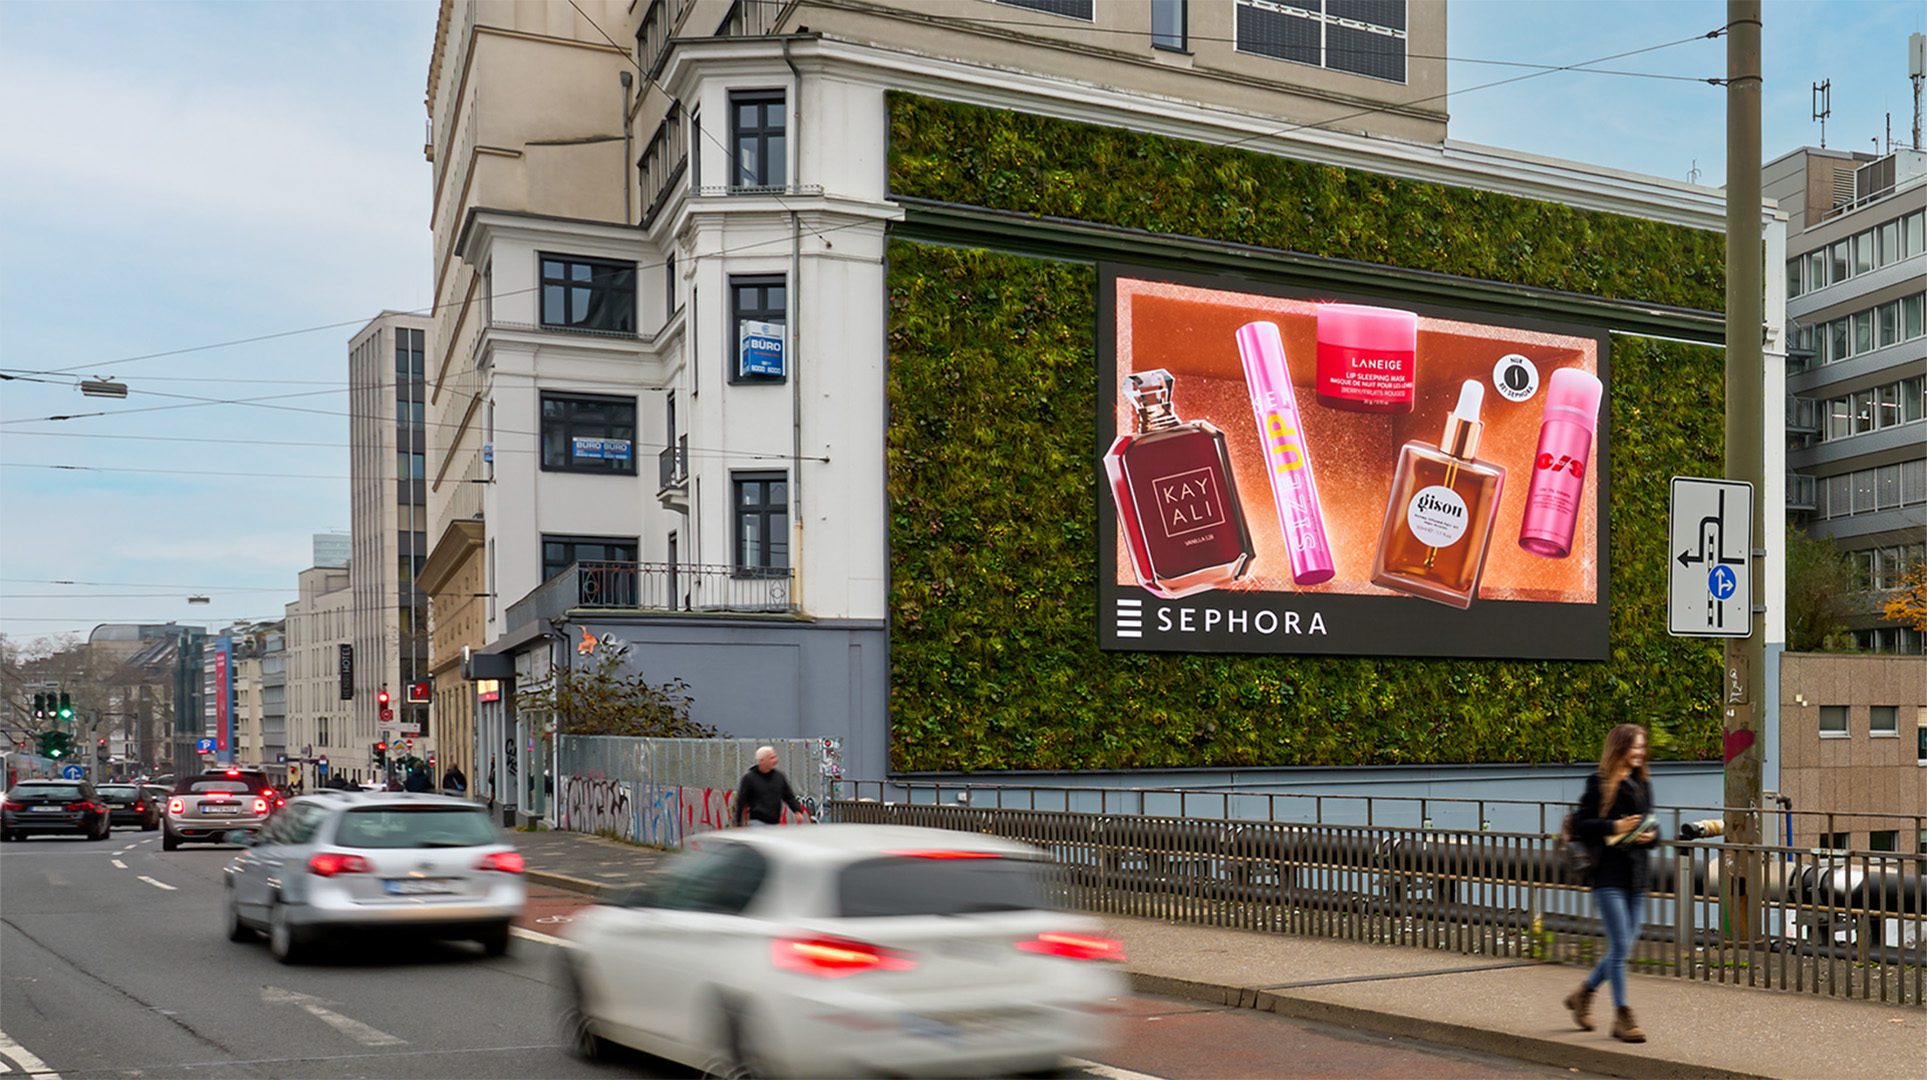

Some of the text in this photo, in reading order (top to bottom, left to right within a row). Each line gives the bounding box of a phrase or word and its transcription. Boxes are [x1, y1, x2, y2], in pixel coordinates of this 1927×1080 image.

[751, 339, 781, 352] BÜRO
[1351, 357, 1402, 370] LANEIGE
[1357, 373, 1390, 382] SLEEPING
[1163, 478, 1208, 503] KAY
[1266, 413, 1317, 552] SIZE UP
[1173, 501, 1212, 525] ALI
[1157, 607, 1328, 635] SEPHORA
[342, 647, 351, 673] HOTEL
